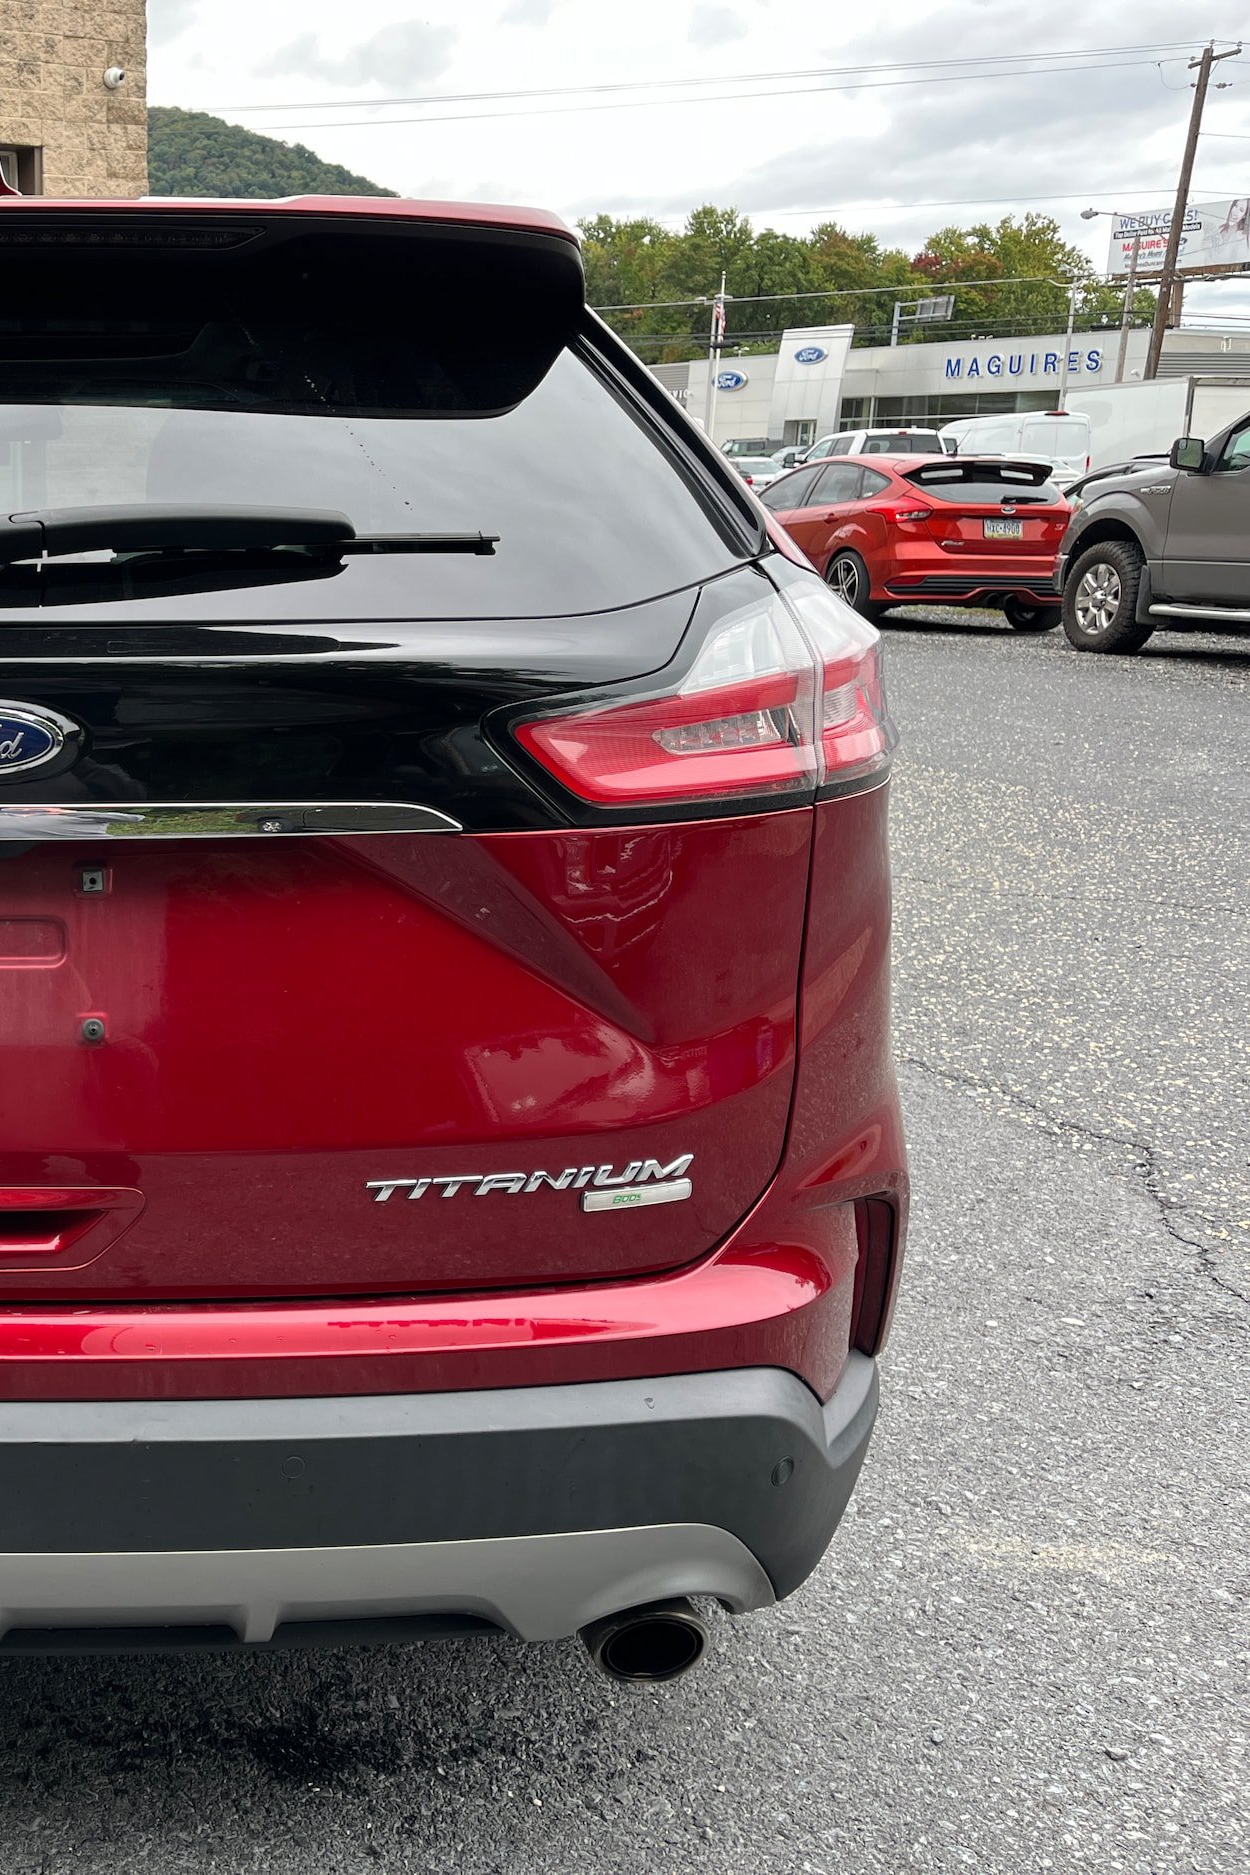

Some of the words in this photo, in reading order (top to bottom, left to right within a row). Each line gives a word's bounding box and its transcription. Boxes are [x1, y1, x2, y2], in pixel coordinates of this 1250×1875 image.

[1120, 218, 1136, 230] WE
[1162, 210, 1198, 225] CS!
[945, 350, 1102, 378] MAGUIRES
[365, 1153, 695, 1202] TITANIUM
